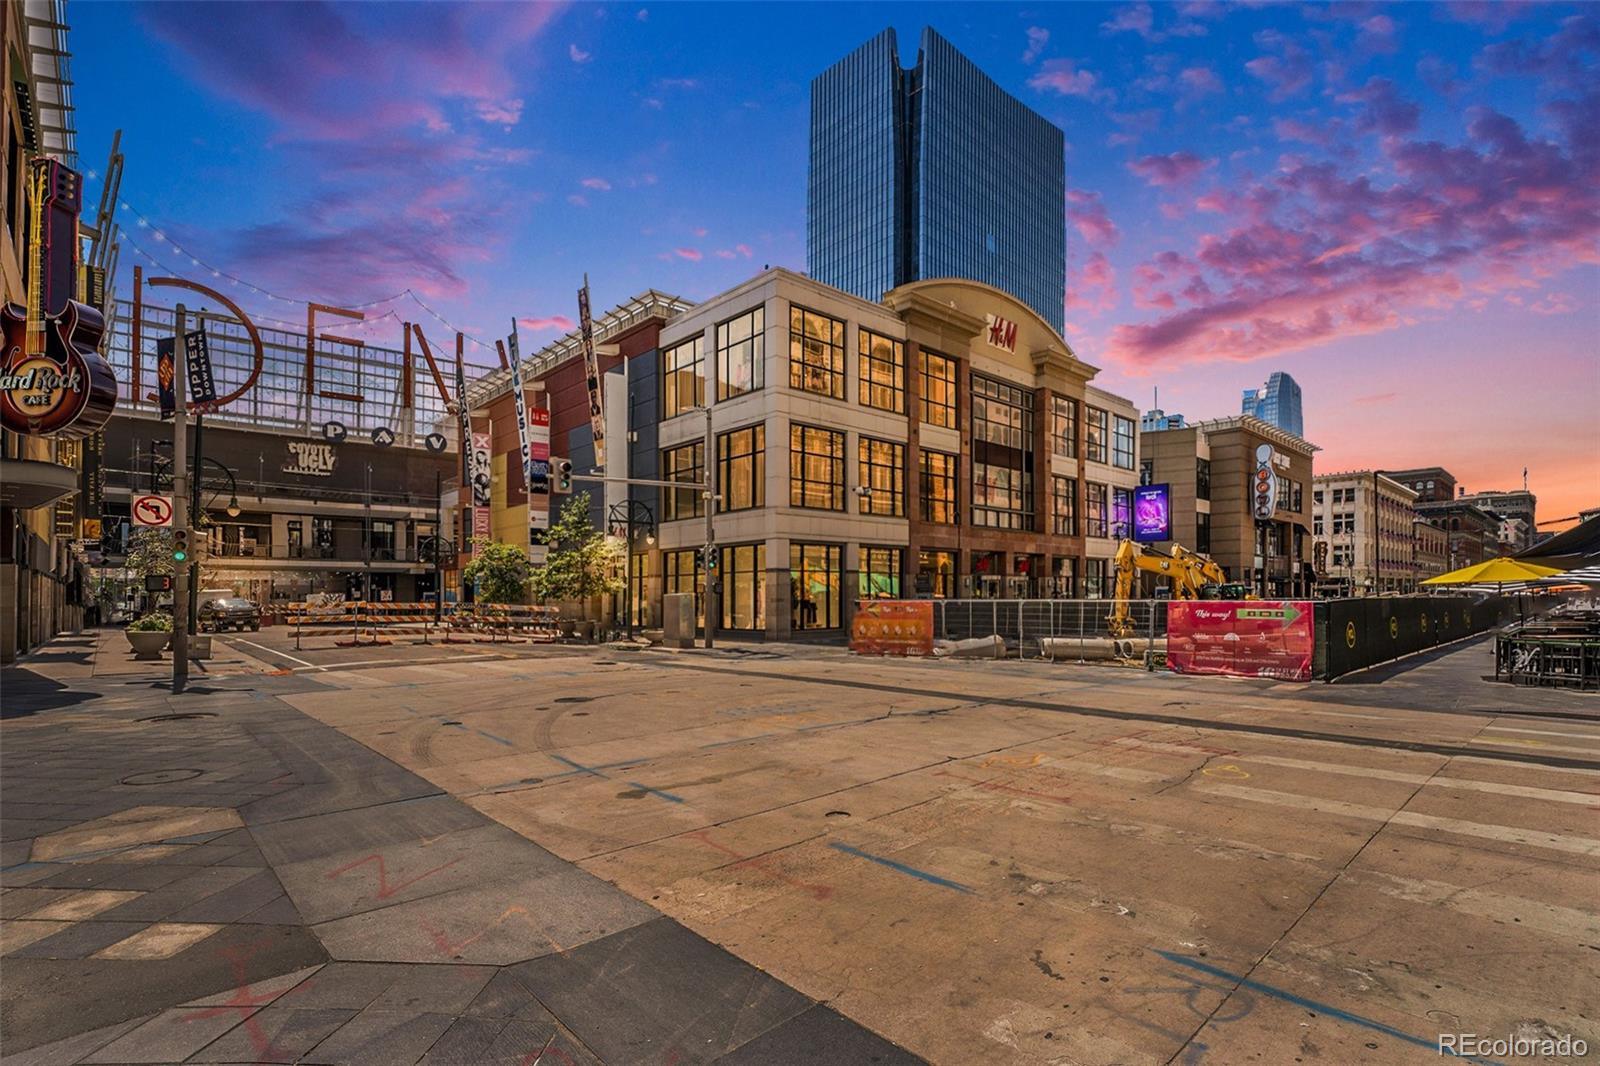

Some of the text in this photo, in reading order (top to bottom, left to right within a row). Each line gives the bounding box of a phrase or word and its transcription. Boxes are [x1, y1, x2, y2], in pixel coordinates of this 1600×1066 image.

[989, 315, 1018, 353] H&M
[0, 367, 81, 393] ard Rock
[188, 336, 203, 398] UPPER
[198, 334, 211, 395] DOWNTOWN
[459, 384, 474, 483] EXPRESS
[515, 393, 528, 456] MUSIC
[288, 442, 331, 456] COYOTE
[298, 453, 336, 470] UGLY
[476, 508, 488, 532] LUCKY
[1195, 609, 1232, 621] This way!
